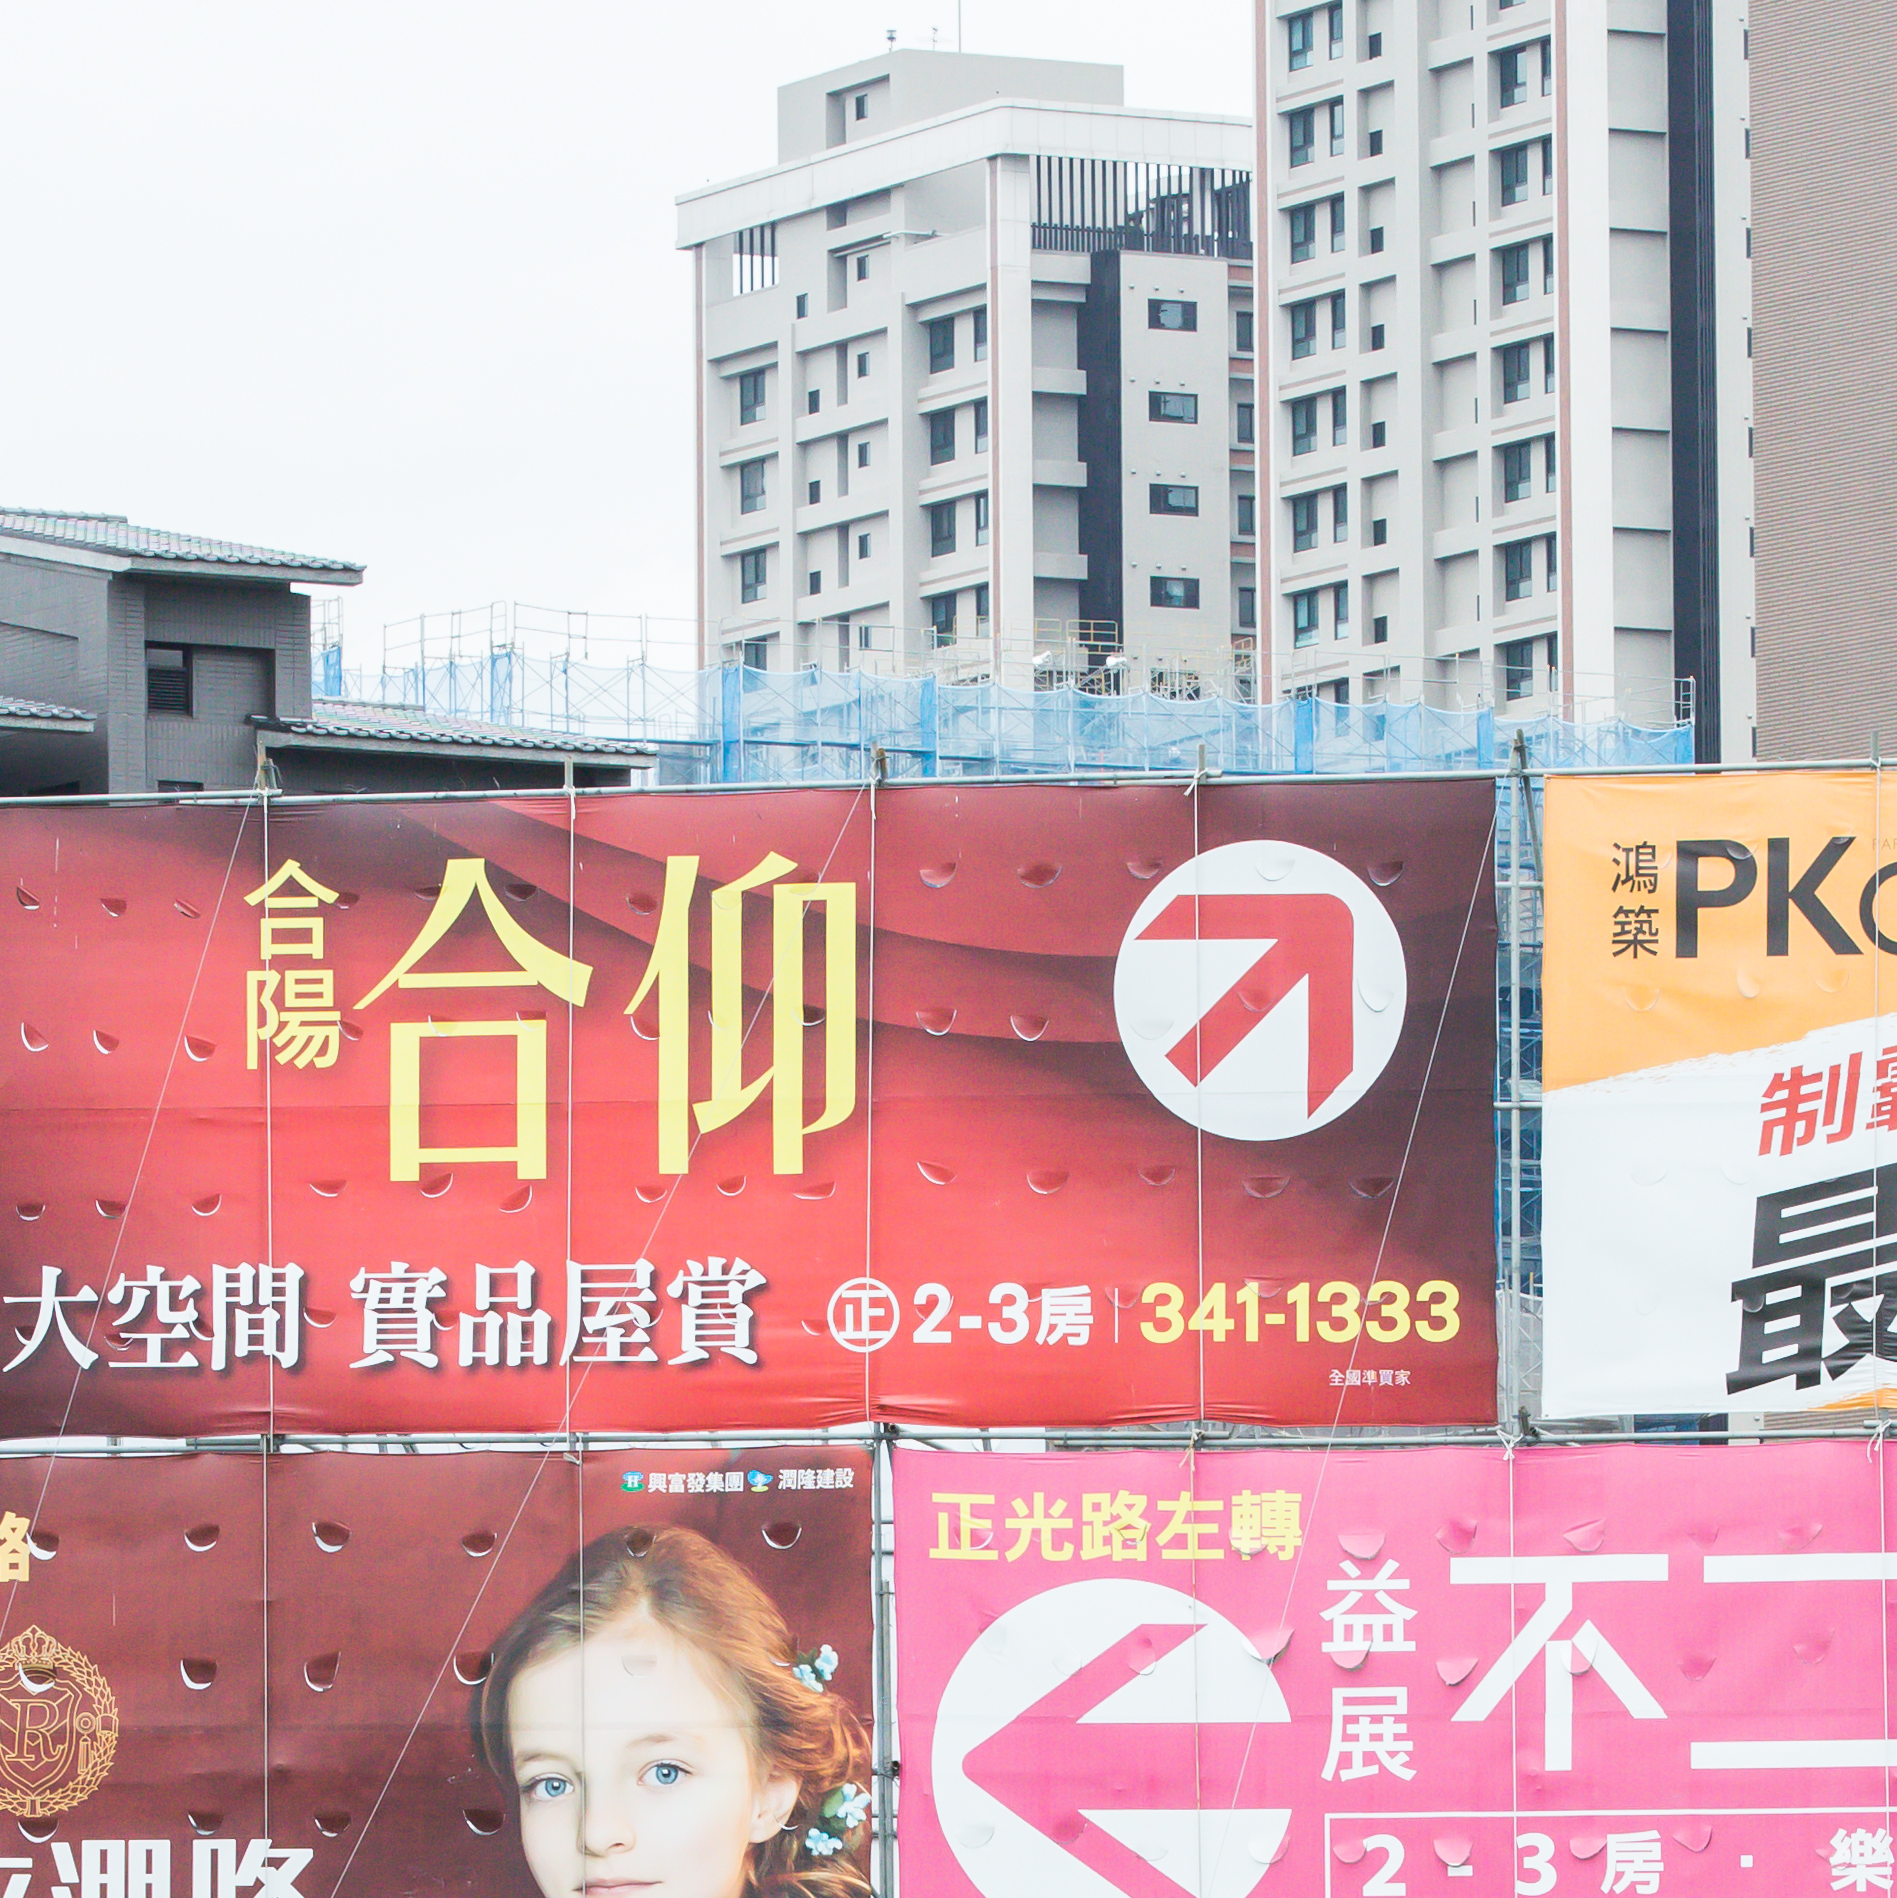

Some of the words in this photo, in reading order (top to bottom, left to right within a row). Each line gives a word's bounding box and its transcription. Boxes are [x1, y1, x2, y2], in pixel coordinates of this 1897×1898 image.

[1611, 839, 1661, 961] 鴻築
[243, 857, 342, 1071] 合陽
[352, 853, 858, 1182] 合仰
[2, 1262, 305, 1373] 大空間
[348, 1255, 769, 1371] 實品屋賞
[912, 1282, 1095, 1347] 2-3房
[1138, 1279, 1463, 1345] 341-1333
[647, 1471, 745, 1493] 興富發集團
[777, 1467, 854, 1491] 潤隆建設
[928, 1488, 1304, 1563] 正光路左轉
[1318, 1558, 1418, 1784] 益展
